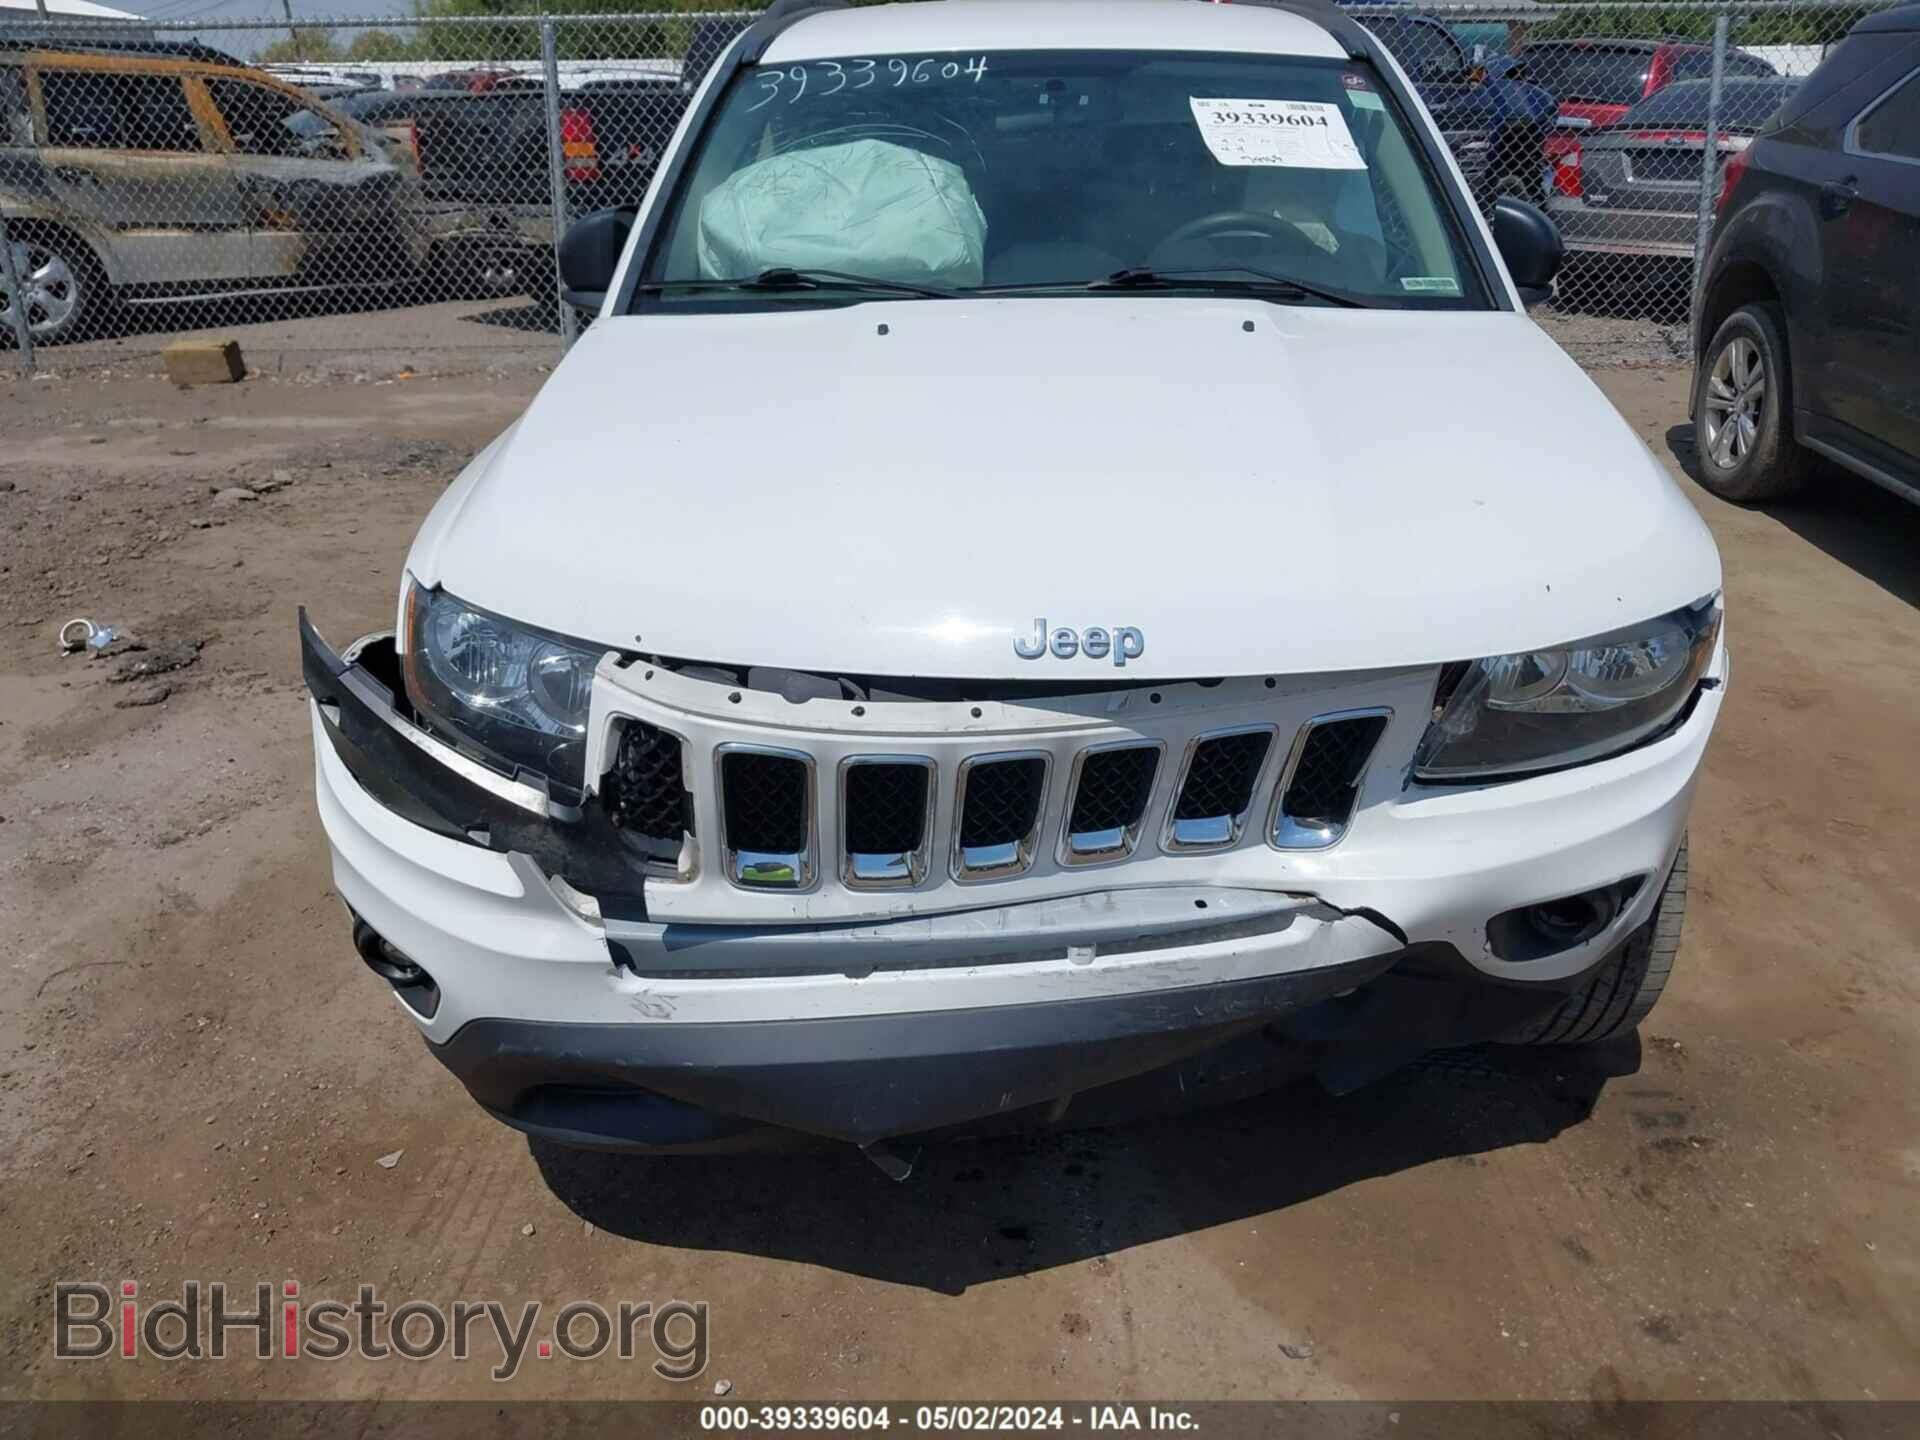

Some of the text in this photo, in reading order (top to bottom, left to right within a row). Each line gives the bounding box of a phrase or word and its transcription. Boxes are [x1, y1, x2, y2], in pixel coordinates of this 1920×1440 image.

[745, 56, 988, 112] 39339604
[1212, 111, 1329, 127] 39339604
[1013, 617, 1144, 667] Jeep
